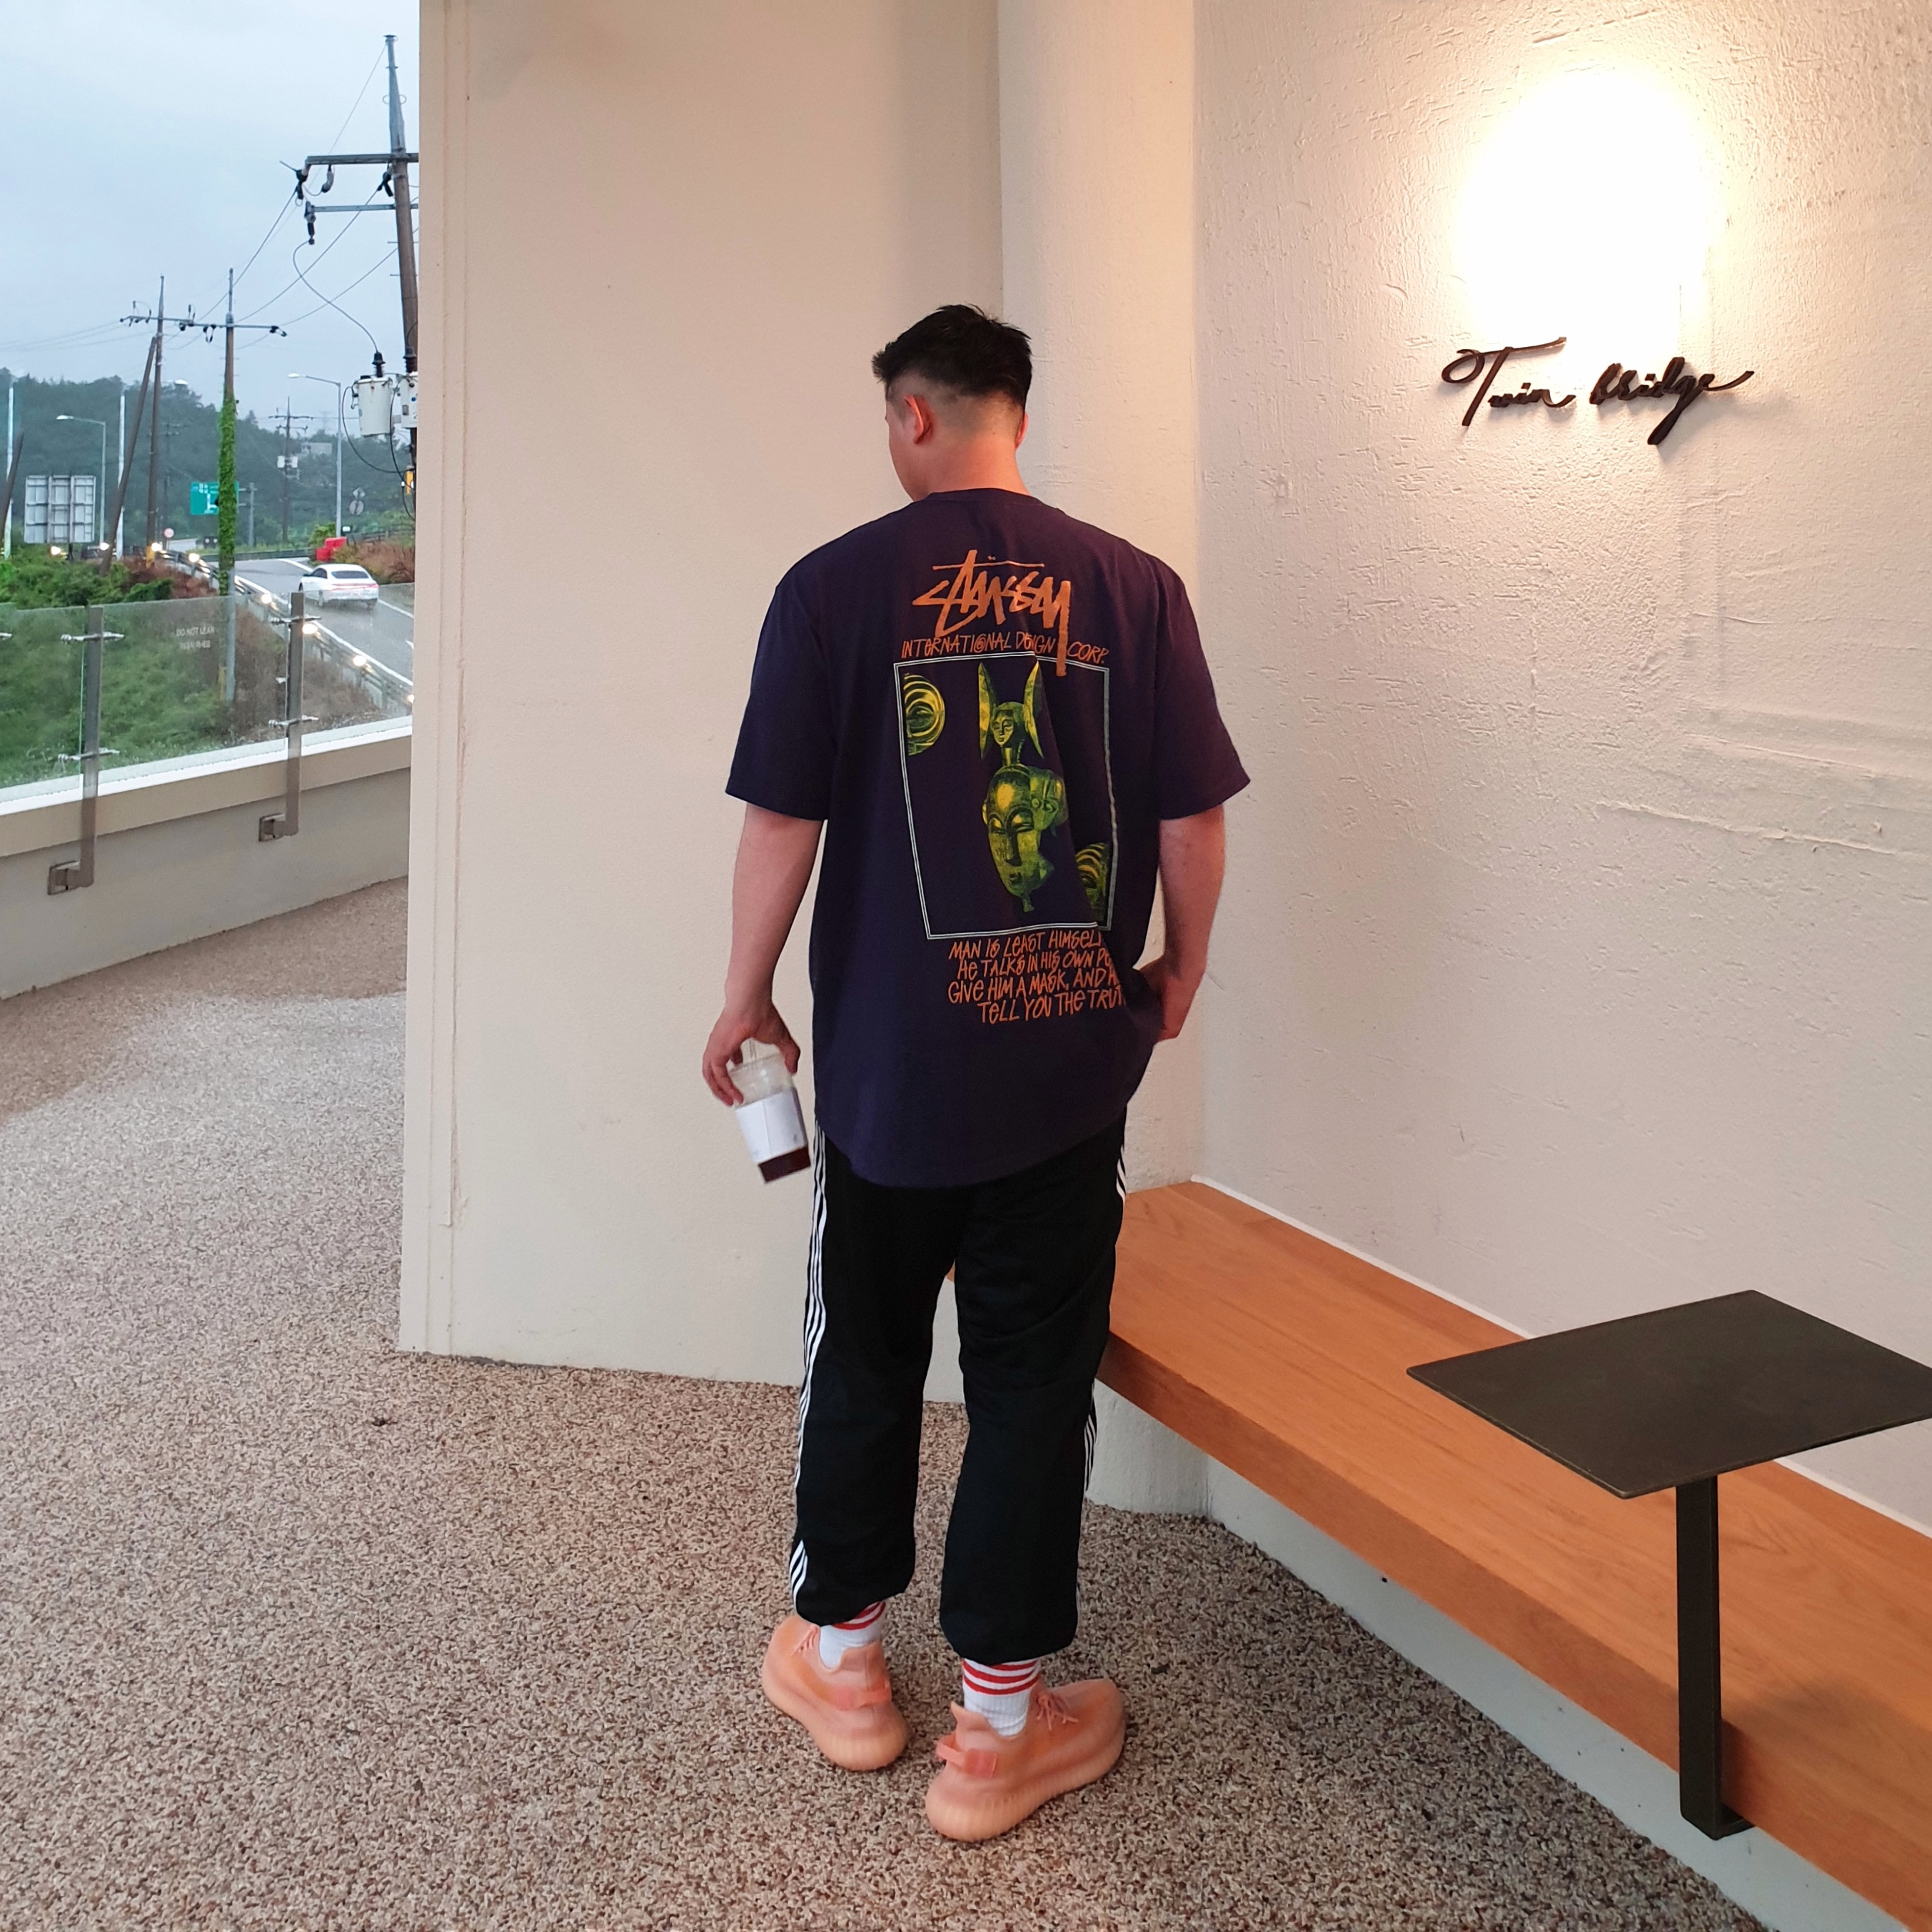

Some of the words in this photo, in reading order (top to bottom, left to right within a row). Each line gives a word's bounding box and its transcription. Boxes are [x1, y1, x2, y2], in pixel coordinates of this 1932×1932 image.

[948, 940, 982, 960] MAN
[985, 938, 1000, 958] IS
[1003, 932, 1046, 957] LEAST
[980, 954, 1025, 978] TALKS
[1027, 952, 1038, 973] IN
[1040, 949, 1060, 970] HIS
[1062, 950, 1095, 968] OWN
[947, 979, 984, 1004] GIVE
[987, 977, 1014, 1001] HIM
[1015, 976, 1027, 998] A
[1072, 967, 1107, 988] AND
[977, 1001, 1020, 1025] TELL
[1024, 995, 1052, 1021] YOU
[1053, 990, 1086, 1015] THE
[1087, 985, 1122, 1010] TRUT
